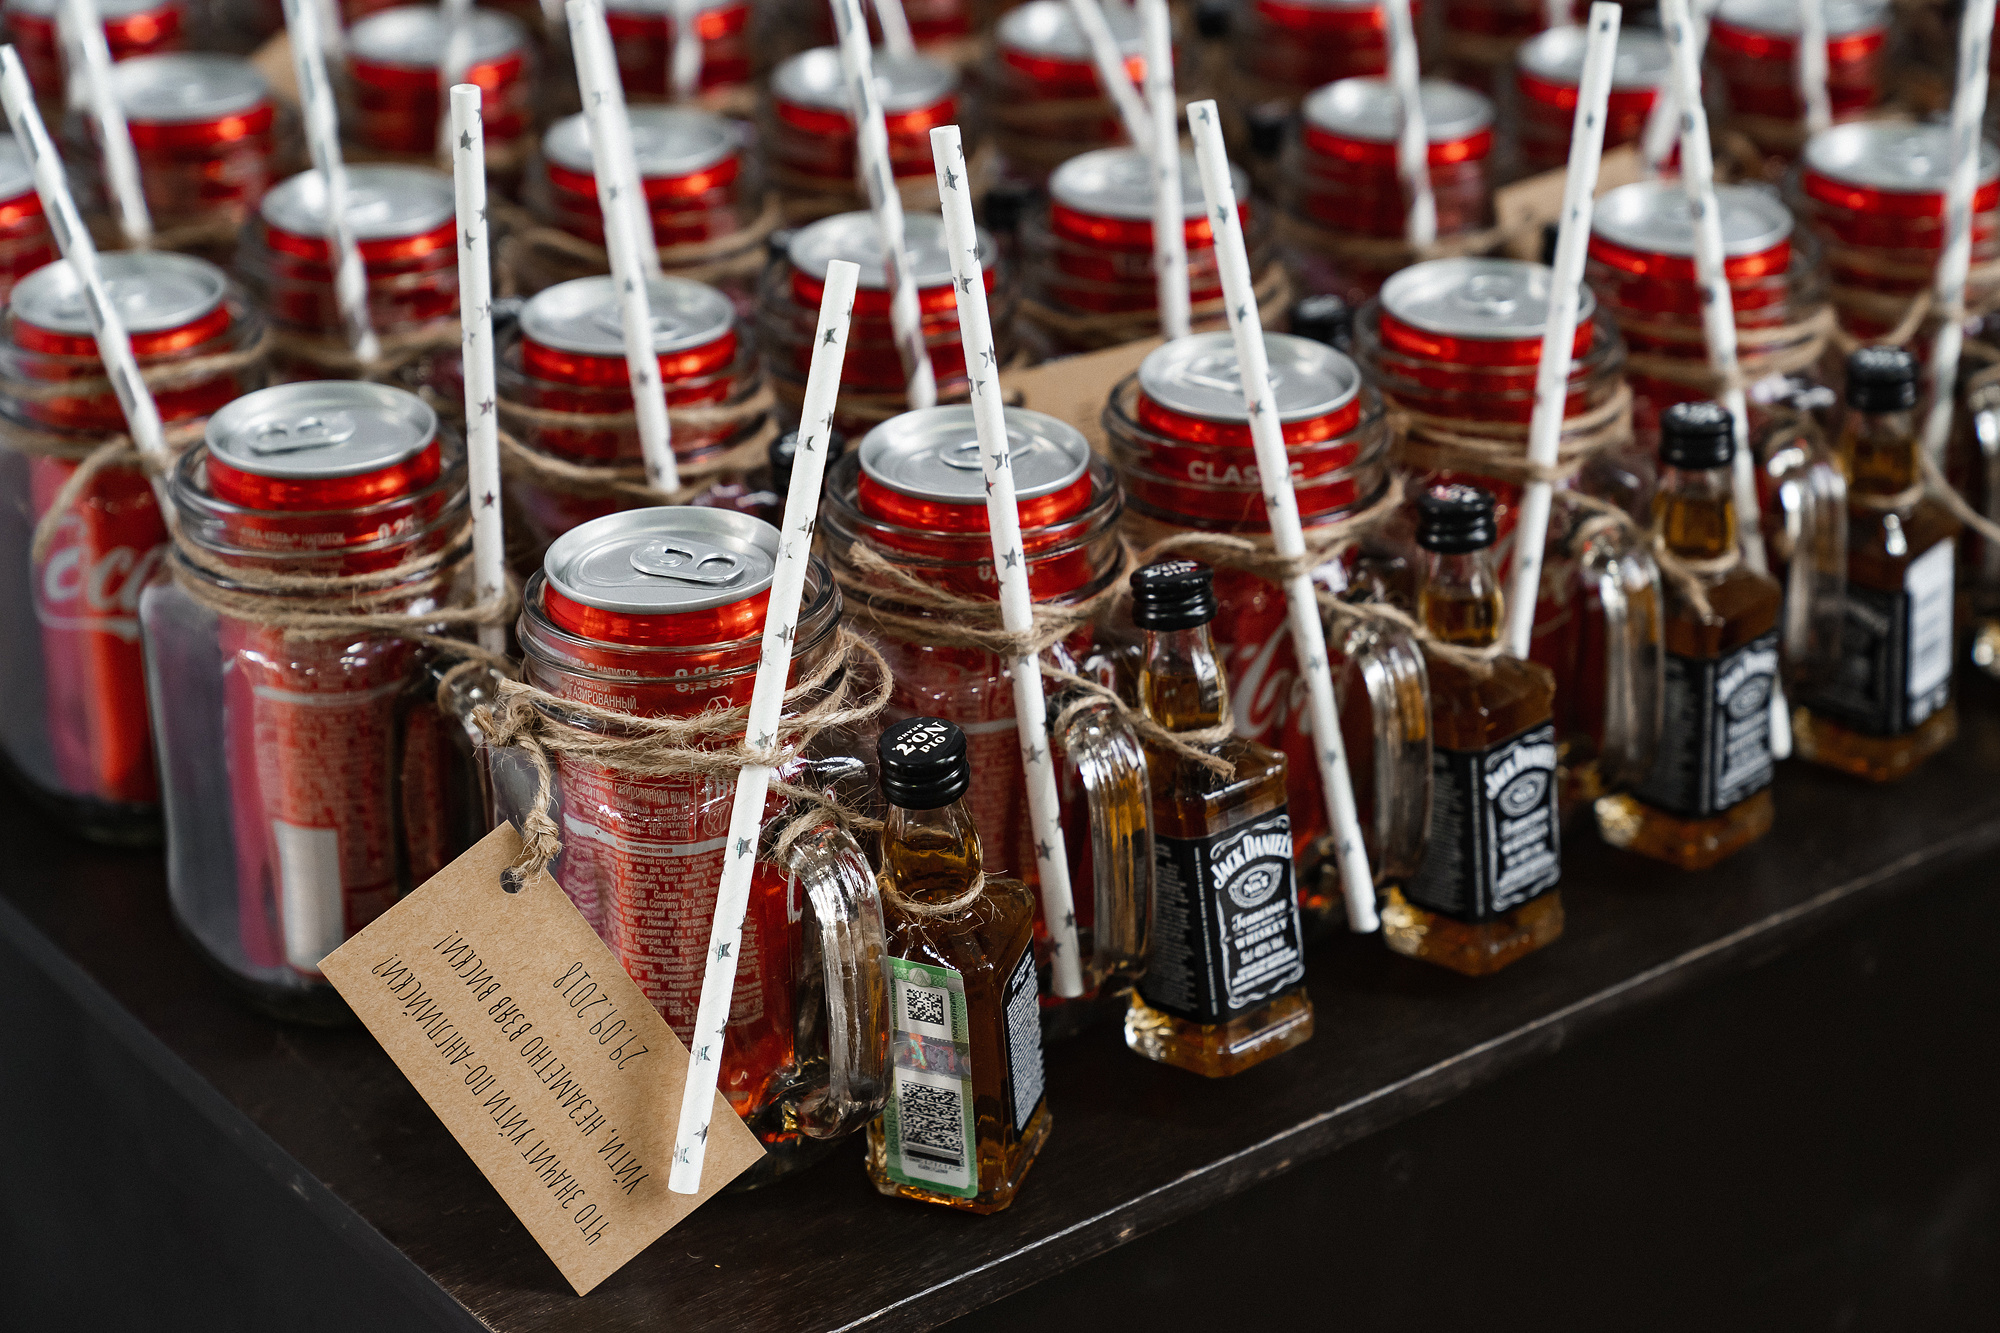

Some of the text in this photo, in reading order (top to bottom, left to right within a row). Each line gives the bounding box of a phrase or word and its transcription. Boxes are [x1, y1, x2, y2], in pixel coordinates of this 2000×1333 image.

[1187, 459, 1304, 484] CLASC
[897, 723, 923, 741] BRAND
[1210, 845, 1246, 890] JACK
[1234, 917, 1288, 950] WHISKEY
[552, 961, 650, 1071] 29.09.2018
[432, 930, 650, 1196] УЙТИ, НЕЗАМЕТНО ВЗЯВ ВИСКИ!
[371, 954, 610, 1246] ЧТО ЗНАЧИТ УЙТИ ПО-АНГЛИЙСКИ?
